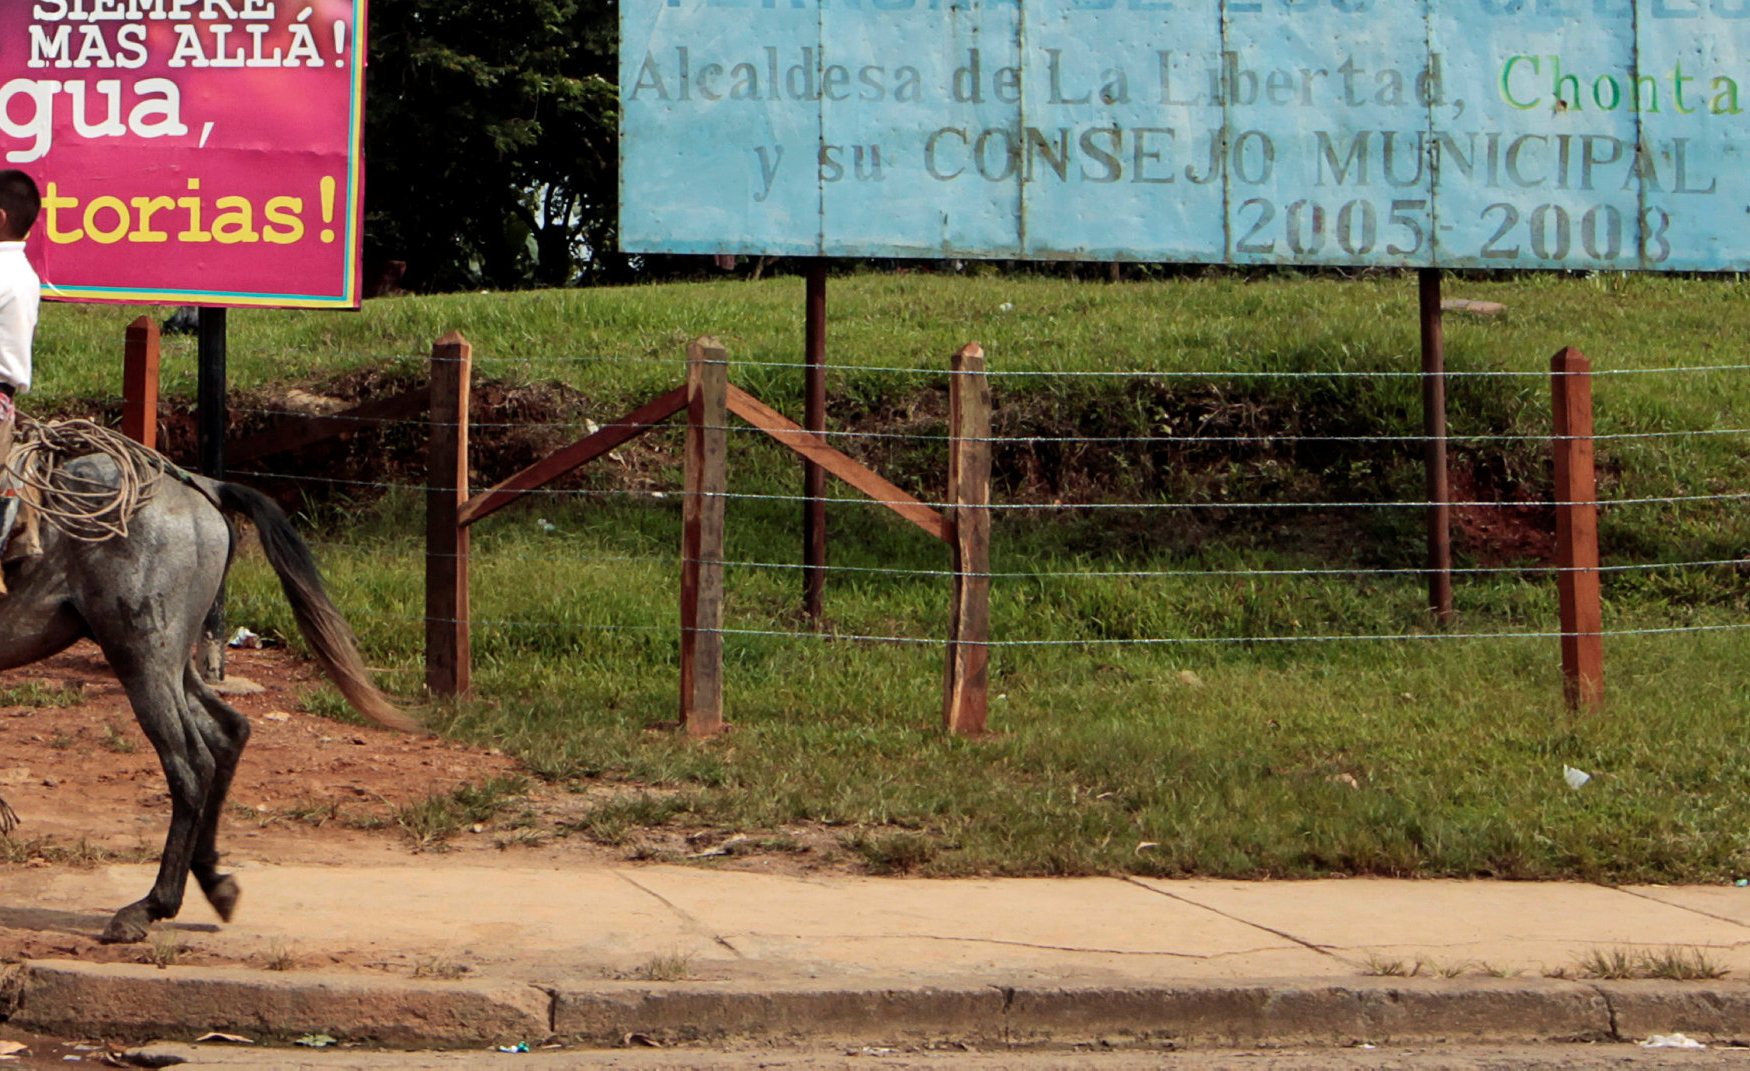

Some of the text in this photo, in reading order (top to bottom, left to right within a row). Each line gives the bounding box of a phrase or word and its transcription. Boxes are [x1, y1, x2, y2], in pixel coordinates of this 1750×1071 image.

[168, 7, 346, 68] ALLÁ!
[628, 45, 924, 105] Alcaldesa
[952, 48, 1023, 105] de
[1047, 48, 1132, 106] La
[1158, 49, 1466, 119] Libertad,
[753, 126, 1717, 203] y su CONSEJO MUNICIPAL
